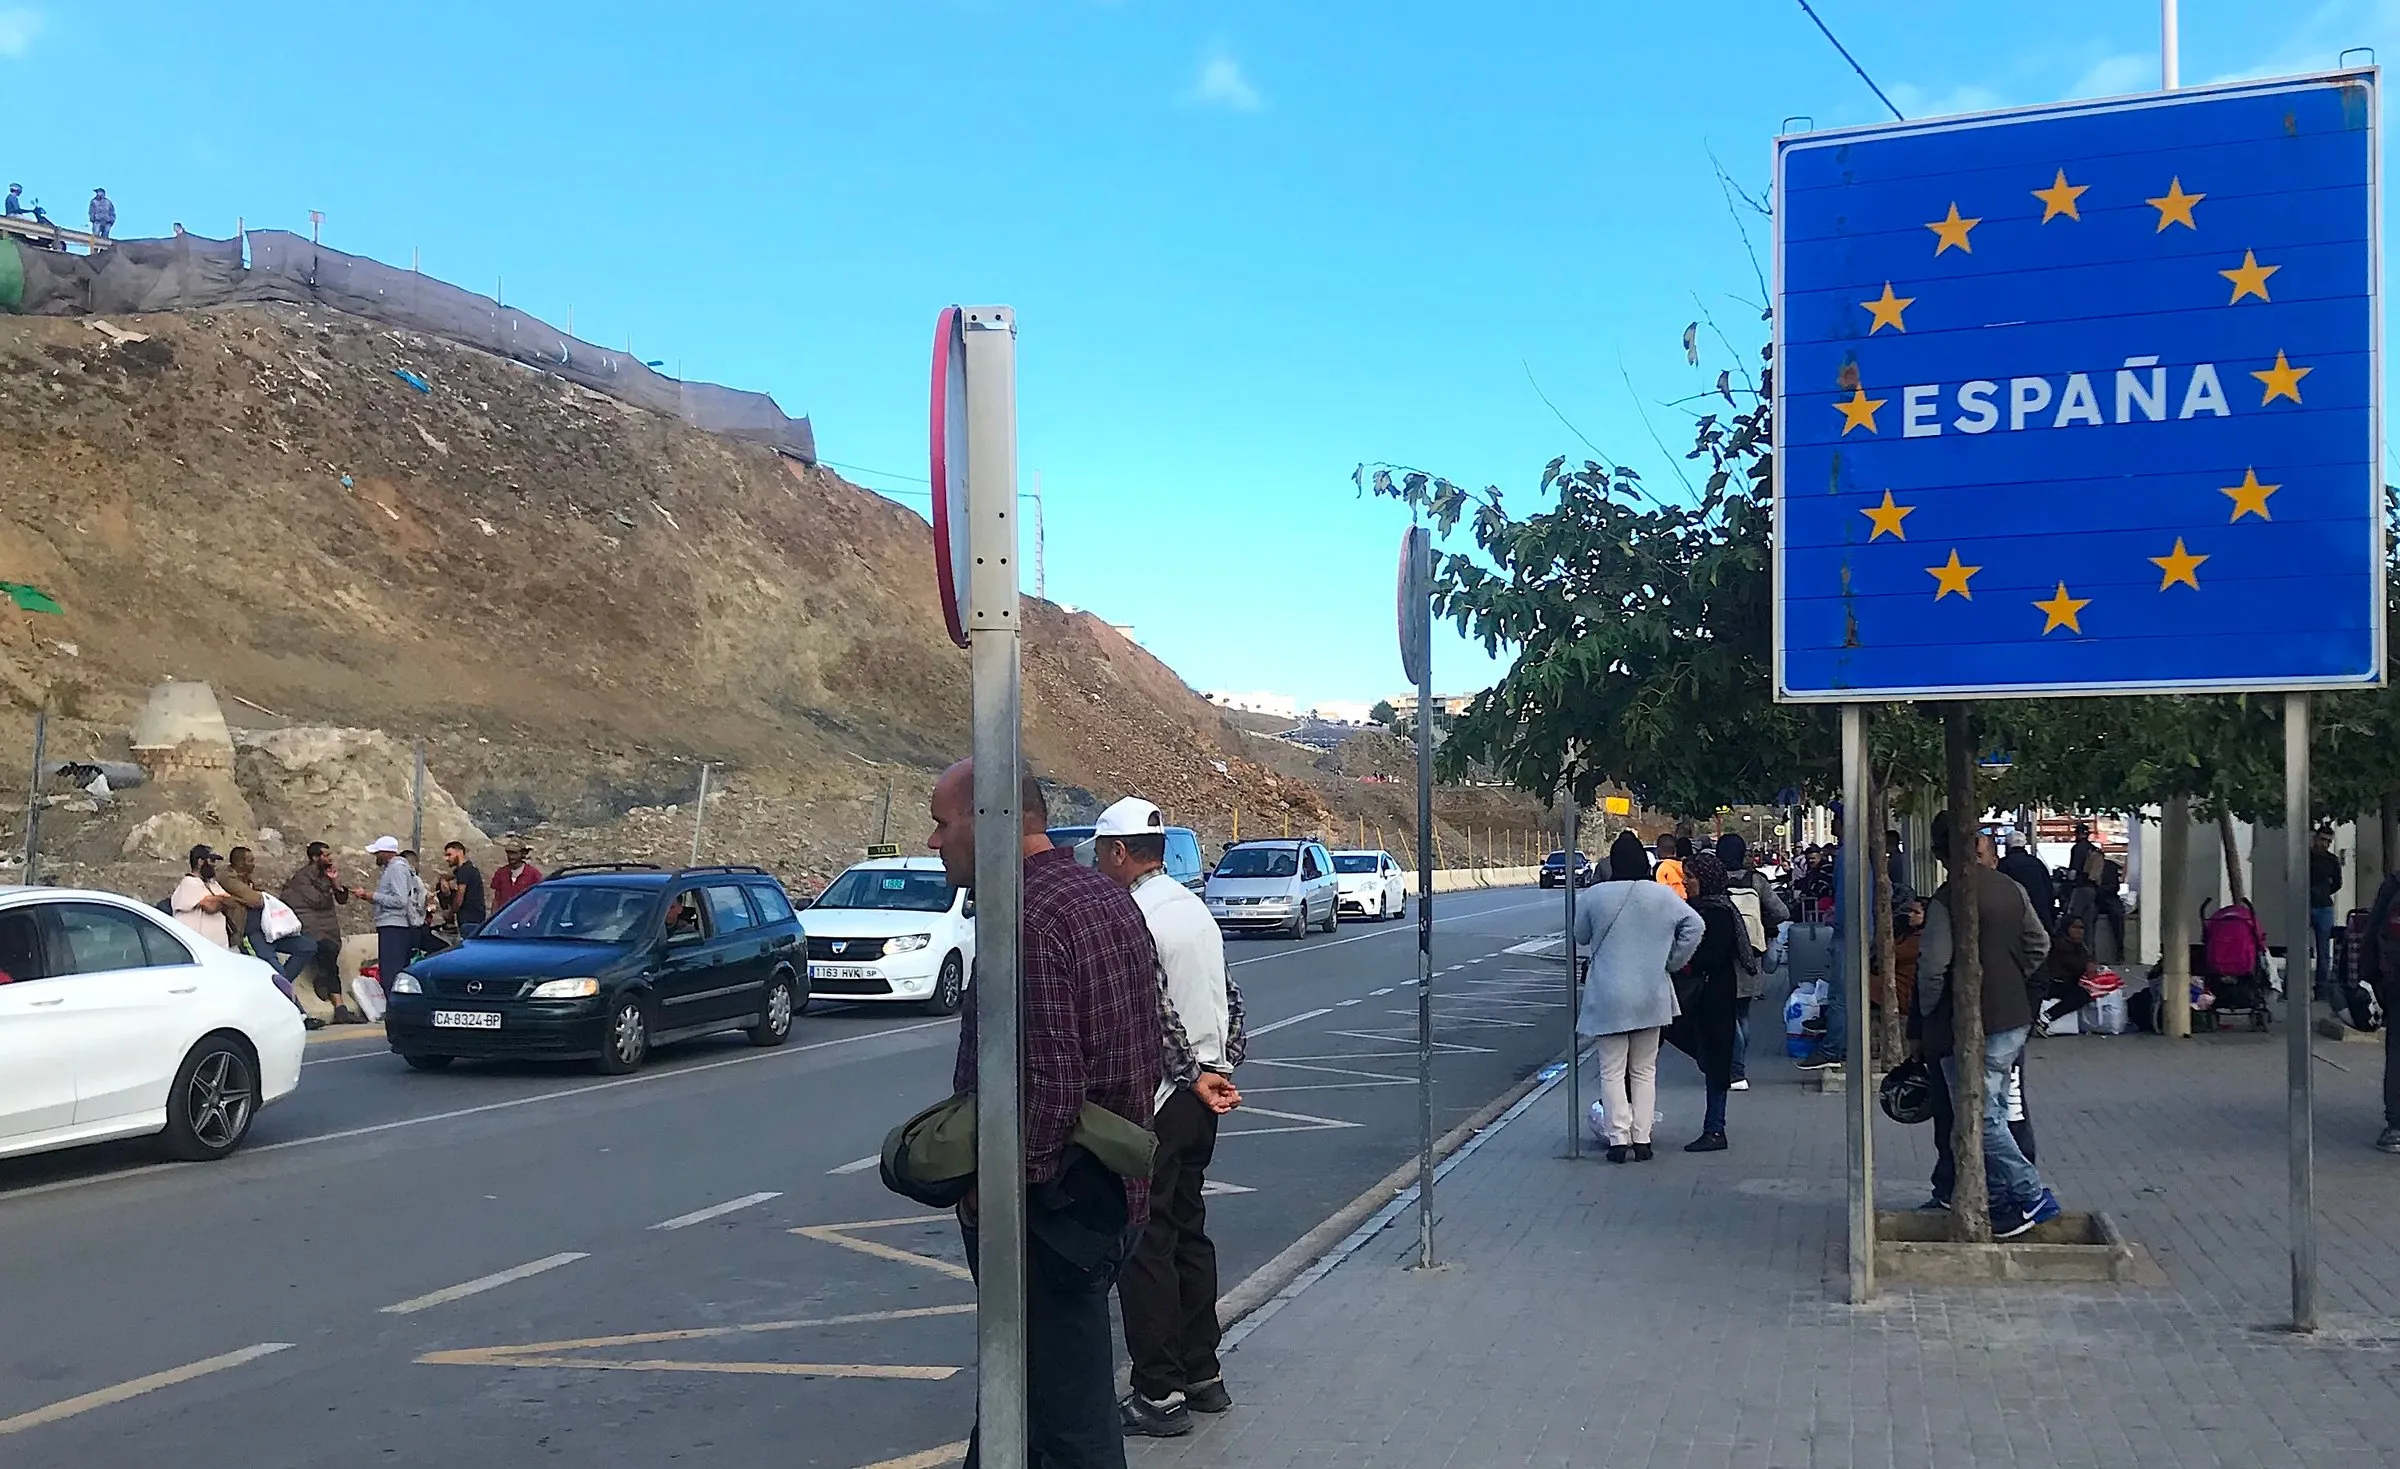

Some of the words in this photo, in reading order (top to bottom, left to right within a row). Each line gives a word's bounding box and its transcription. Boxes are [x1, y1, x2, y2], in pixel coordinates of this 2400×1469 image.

[1903, 355, 2231, 438] ESPAÑA
[876, 846, 895, 854] TAXI
[816, 967, 838, 978] 1163
[841, 968, 861, 978] HVK
